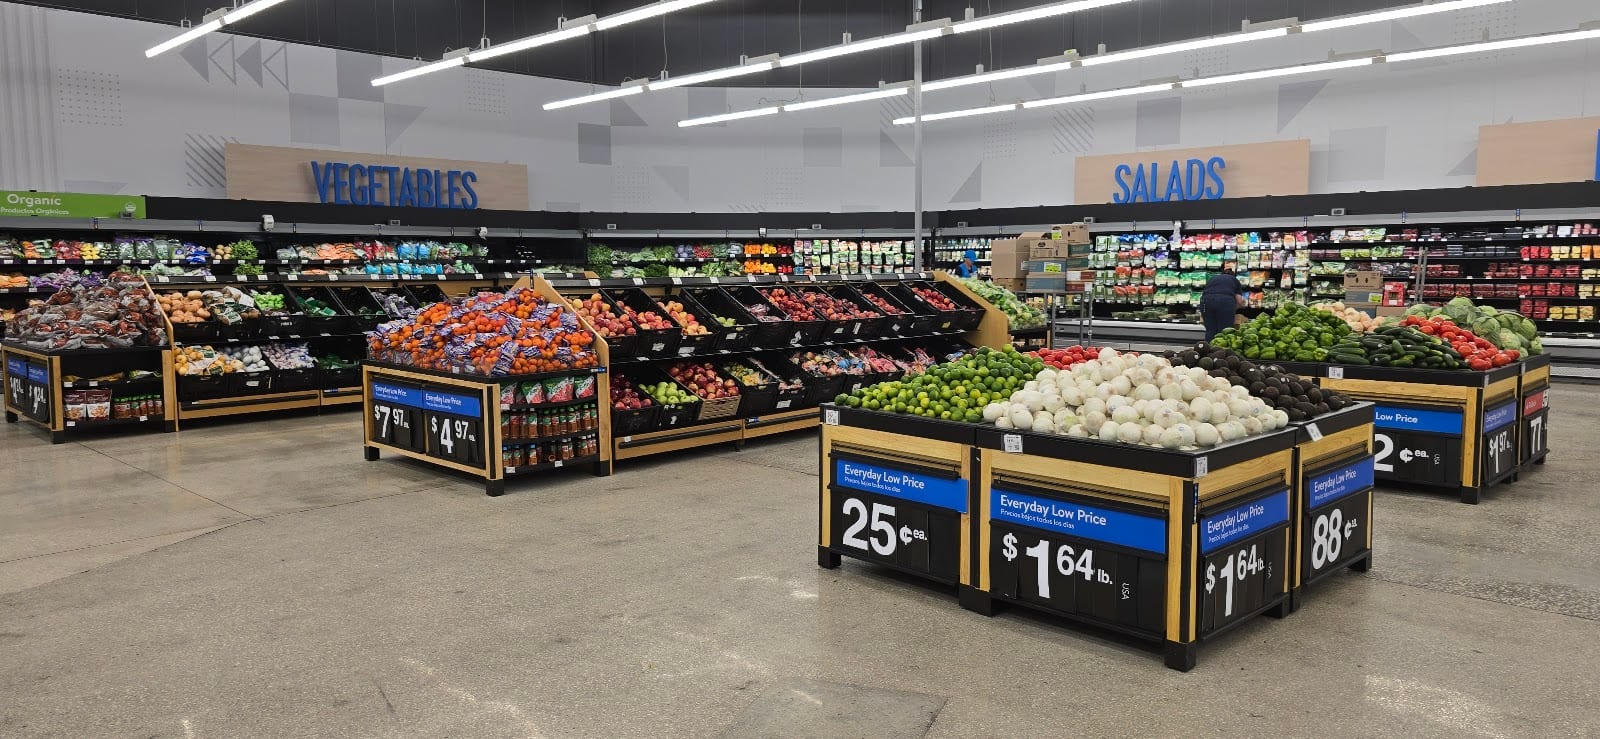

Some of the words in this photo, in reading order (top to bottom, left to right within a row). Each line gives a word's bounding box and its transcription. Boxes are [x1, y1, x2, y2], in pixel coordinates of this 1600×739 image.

[310, 160, 478, 210] VEGETABLES
[1112, 156, 1226, 205] SALADS
[7, 194, 61, 207] Organic
[1376, 412, 1393, 421] Low
[1396, 414, 1418, 423] Price
[844, 464, 882, 482] Everyday
[883, 471, 901, 484] Low
[902, 474, 925, 489] Price
[1314, 475, 1336, 493] Everyday
[1345, 469, 1357, 481] Price
[1000, 494, 1050, 517] Everyday
[1051, 504, 1075, 520] Low
[1077, 508, 1107, 526] Price
[1208, 515, 1236, 533] Everyday
[1237, 511, 1248, 522] Low
[1250, 505, 1264, 518] Price
[1097, 568, 1113, 585] lb.
